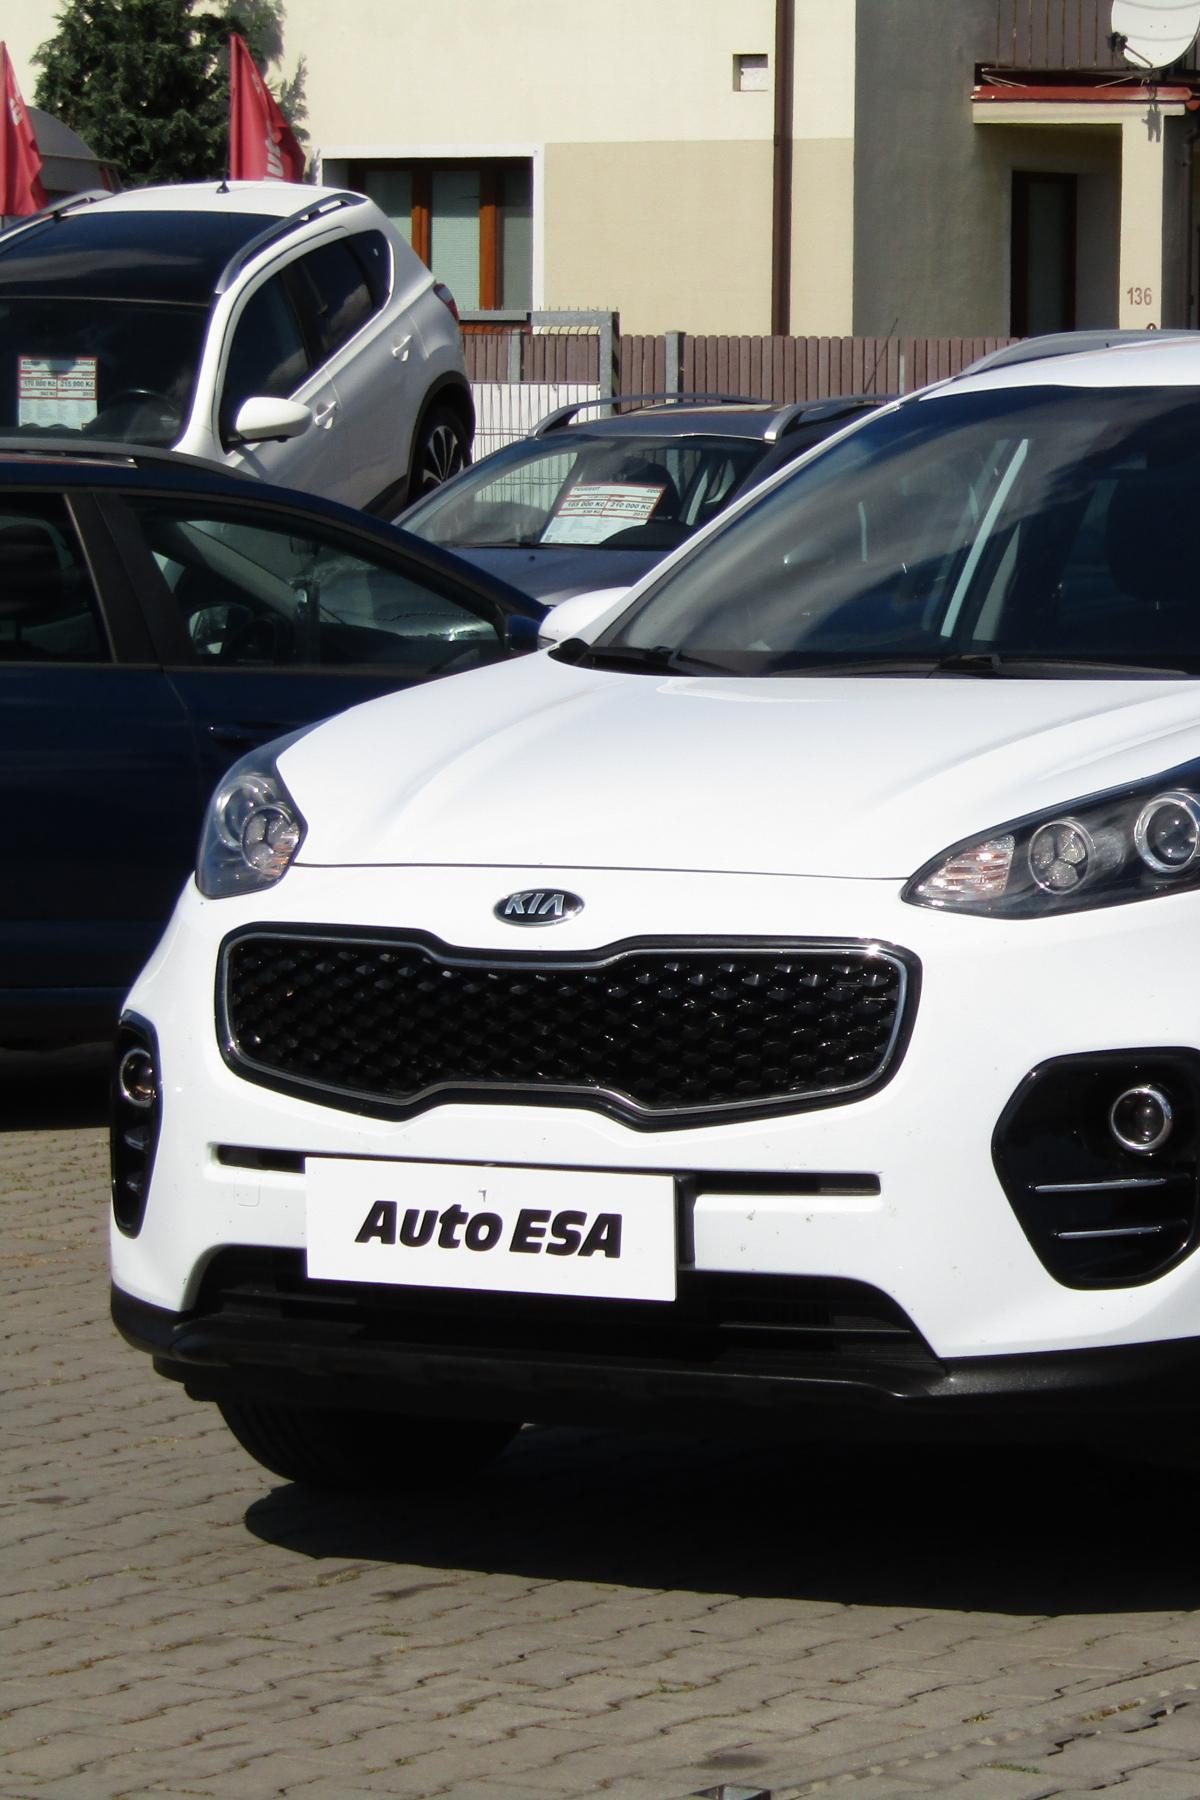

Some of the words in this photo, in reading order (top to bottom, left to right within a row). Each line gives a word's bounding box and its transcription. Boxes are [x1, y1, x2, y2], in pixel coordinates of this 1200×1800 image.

[1127, 287, 1152, 306] 136
[504, 892, 565, 916] KIA
[354, 1199, 503, 1252] Auto
[508, 1208, 623, 1259] ESA
